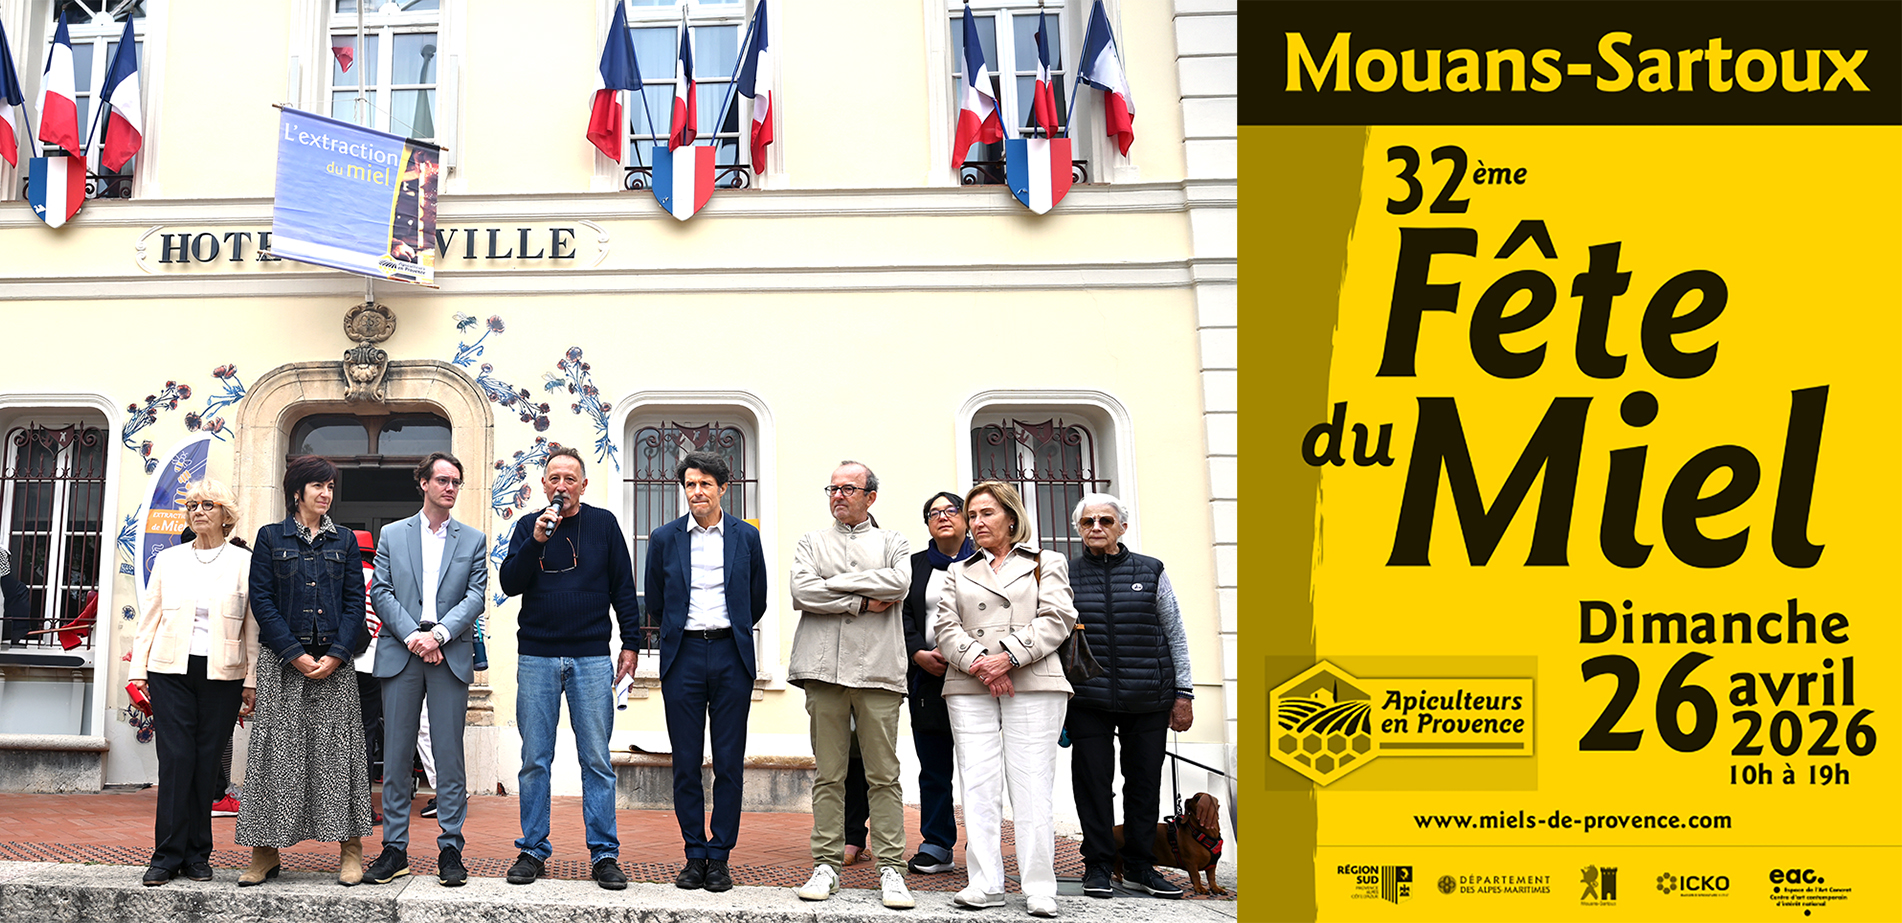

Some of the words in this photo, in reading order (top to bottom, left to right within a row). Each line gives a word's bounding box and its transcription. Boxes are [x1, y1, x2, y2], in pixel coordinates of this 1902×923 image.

[1284, 31, 1871, 93] Mouans-Sartoux
[284, 122, 398, 167] L'extraction
[326, 161, 343, 175] du
[347, 164, 390, 187] miel
[158, 231, 282, 263] HOTE
[435, 228, 576, 260] VILLE
[1375, 219, 1729, 380] Fête
[1301, 401, 1395, 467] du
[1385, 384, 1830, 569] Miel
[151, 523, 161, 531] de
[153, 511, 186, 520] EXTRACTI
[1579, 597, 1850, 645] Dimanche
[1729, 656, 1855, 707] avril
[1381, 689, 1523, 716] Apiculteurs
[1578, 651, 1718, 753] 26
[1381, 718, 1409, 734] en
[1417, 712, 1525, 734] Provence
[1731, 708, 1877, 757] 2026
[1730, 762, 1773, 785] 10h
[1782, 762, 1795, 785] à
[1809, 762, 1850, 786] 19h
[1413, 809, 1732, 833] www.miels-de-provence.com
[1337, 864, 1379, 875] RÉGION
[1356, 875, 1379, 885] SUD
[1460, 873, 1550, 884] DÉPARTEMENT
[1460, 885, 1475, 894] DES
[1680, 875, 1730, 891] ICKO
